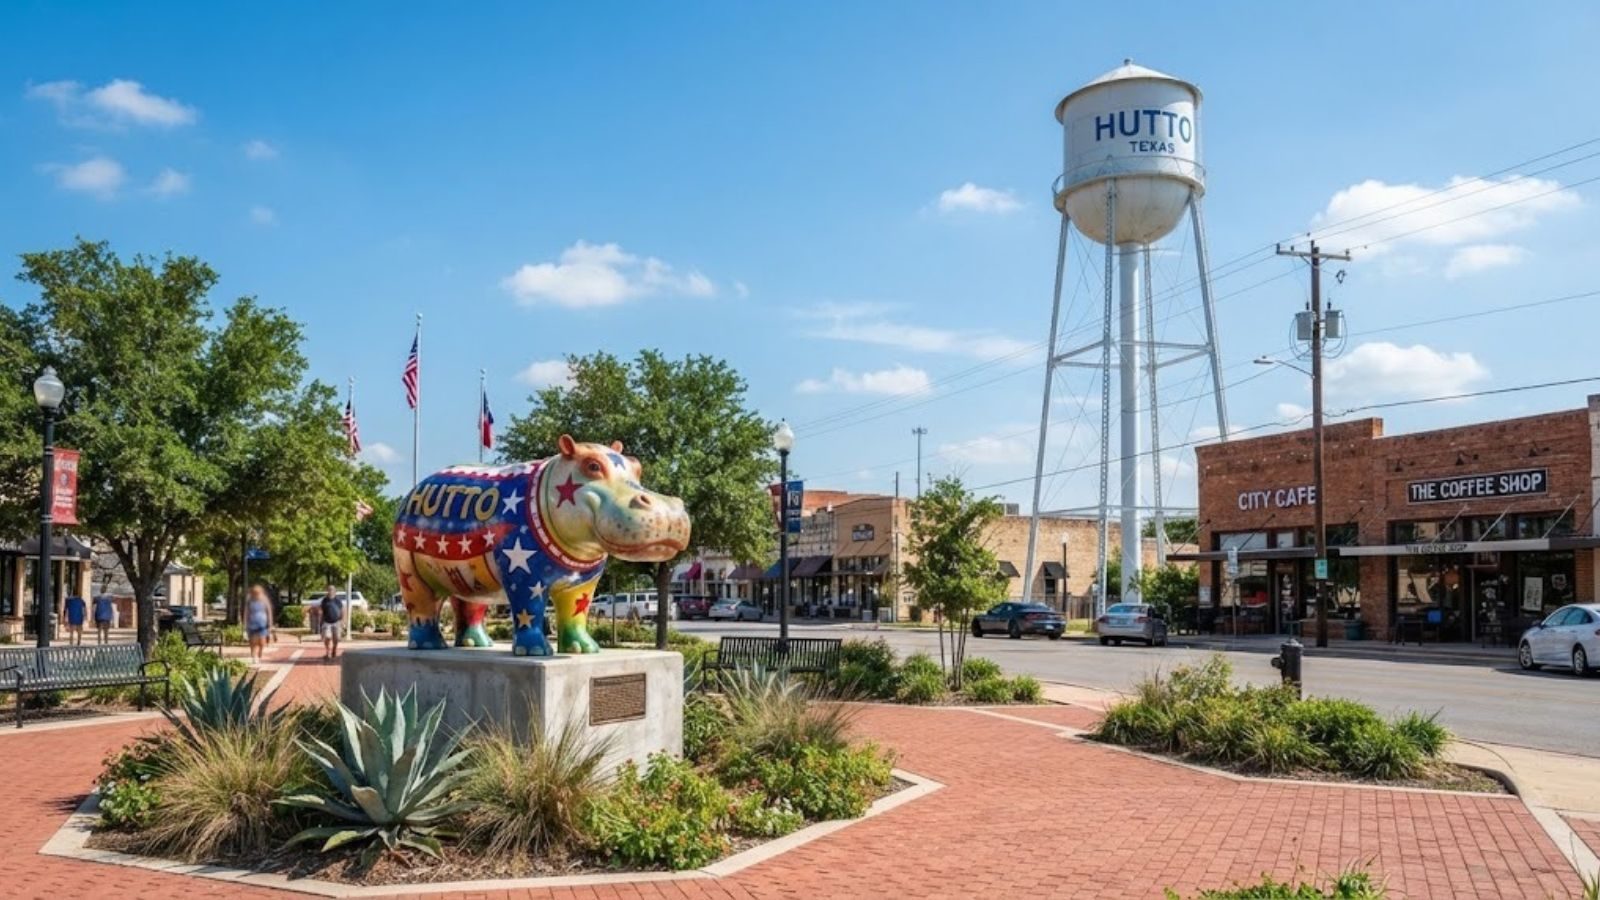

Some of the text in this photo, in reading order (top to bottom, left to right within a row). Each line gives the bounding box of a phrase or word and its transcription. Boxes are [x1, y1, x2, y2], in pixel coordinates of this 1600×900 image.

[1095, 109, 1192, 143] HUTTO
[1128, 140, 1175, 154] TEXAS
[1238, 486, 1317, 510] CITY CAFE
[1411, 473, 1542, 500] THE COFFEE SHOP
[405, 483, 499, 521] HUTTO
